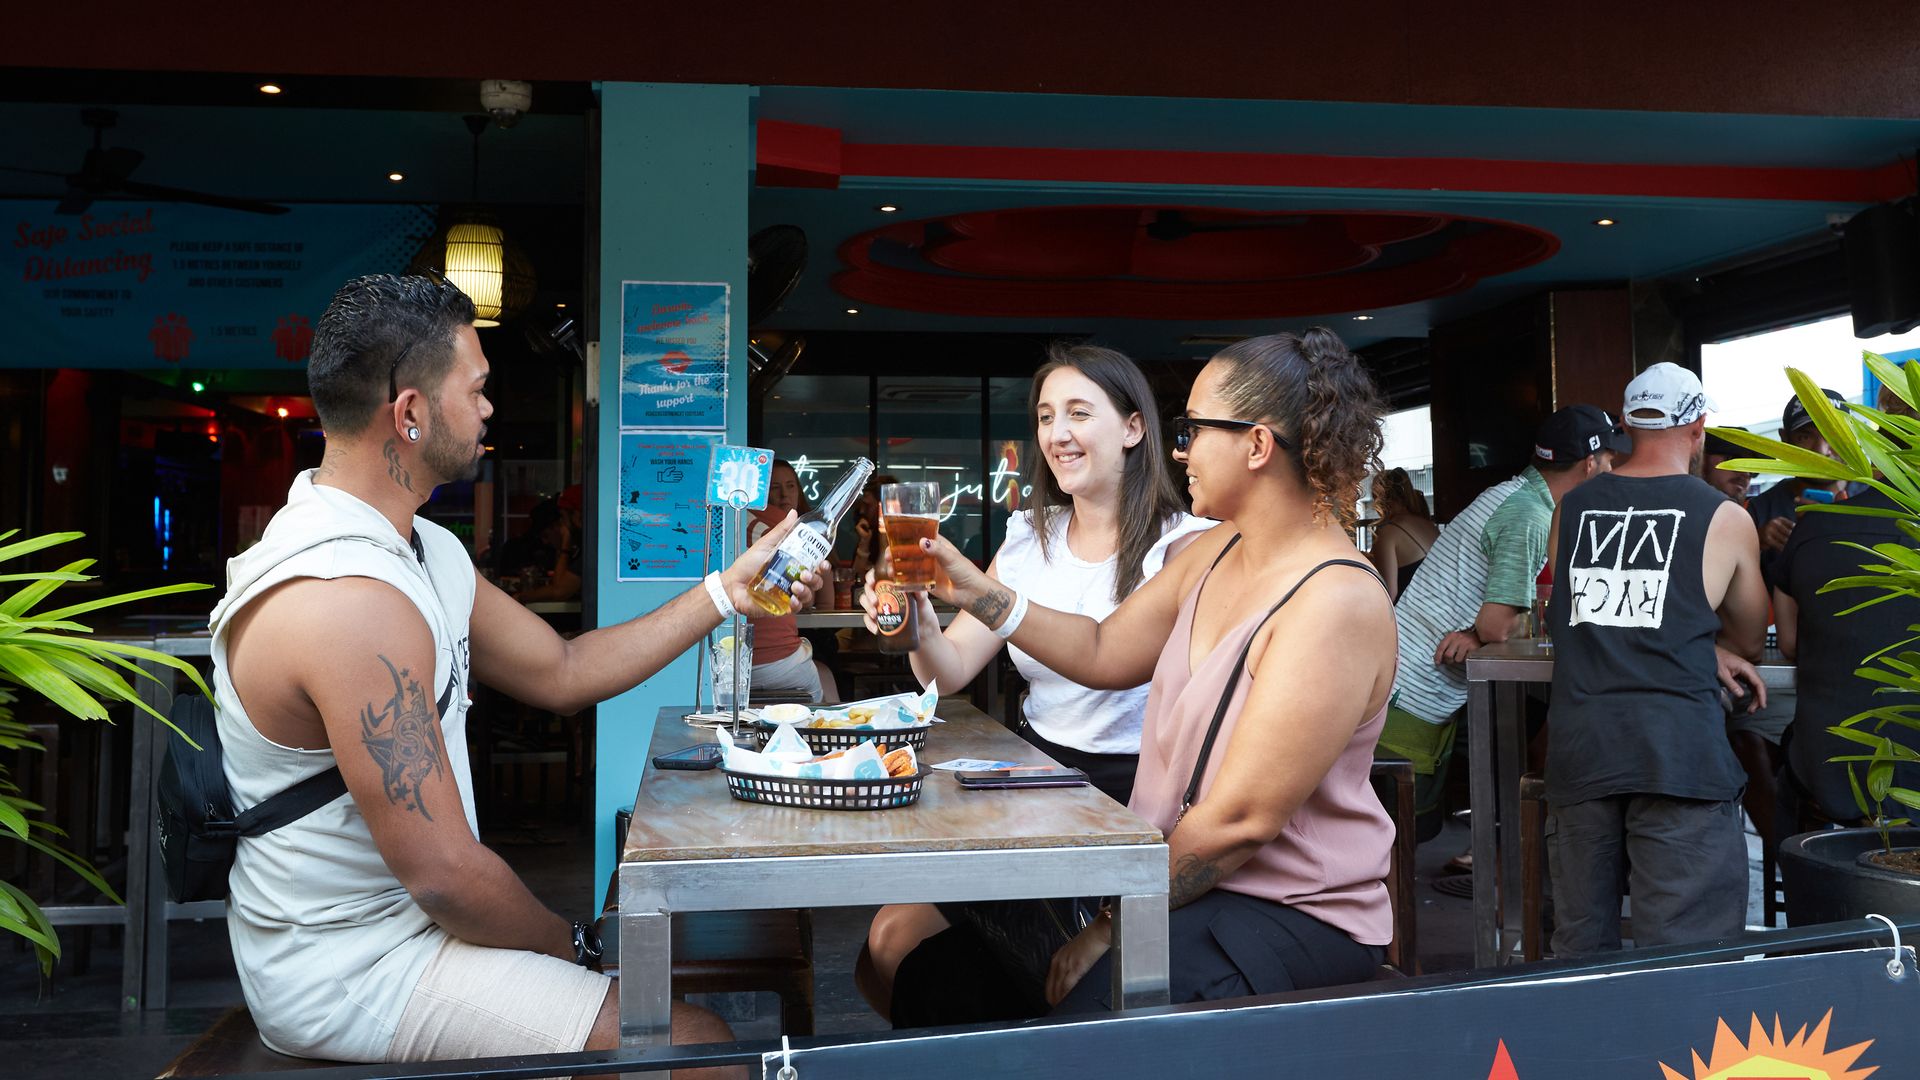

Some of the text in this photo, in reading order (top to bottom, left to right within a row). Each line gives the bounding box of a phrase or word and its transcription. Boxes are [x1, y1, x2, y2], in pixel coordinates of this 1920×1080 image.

[15, 208, 155, 250] Safe Social
[169, 241, 200, 252] PLEASE
[203, 241, 223, 252] KEEP
[231, 241, 252, 252] SAFE
[22, 250, 156, 283] Distancing
[187, 259, 220, 270] METRES
[222, 259, 260, 270] BETWEEN
[262, 259, 303, 270] YOURSELF
[188, 277, 284, 288] AND OTHER CUSTOMERS
[224, 326, 257, 336] METRES
[638, 375, 711, 396] Thanks for the
[656, 393, 696, 409] support
[1588, 434, 1601, 451] FJ
[717, 461, 760, 502] 30
